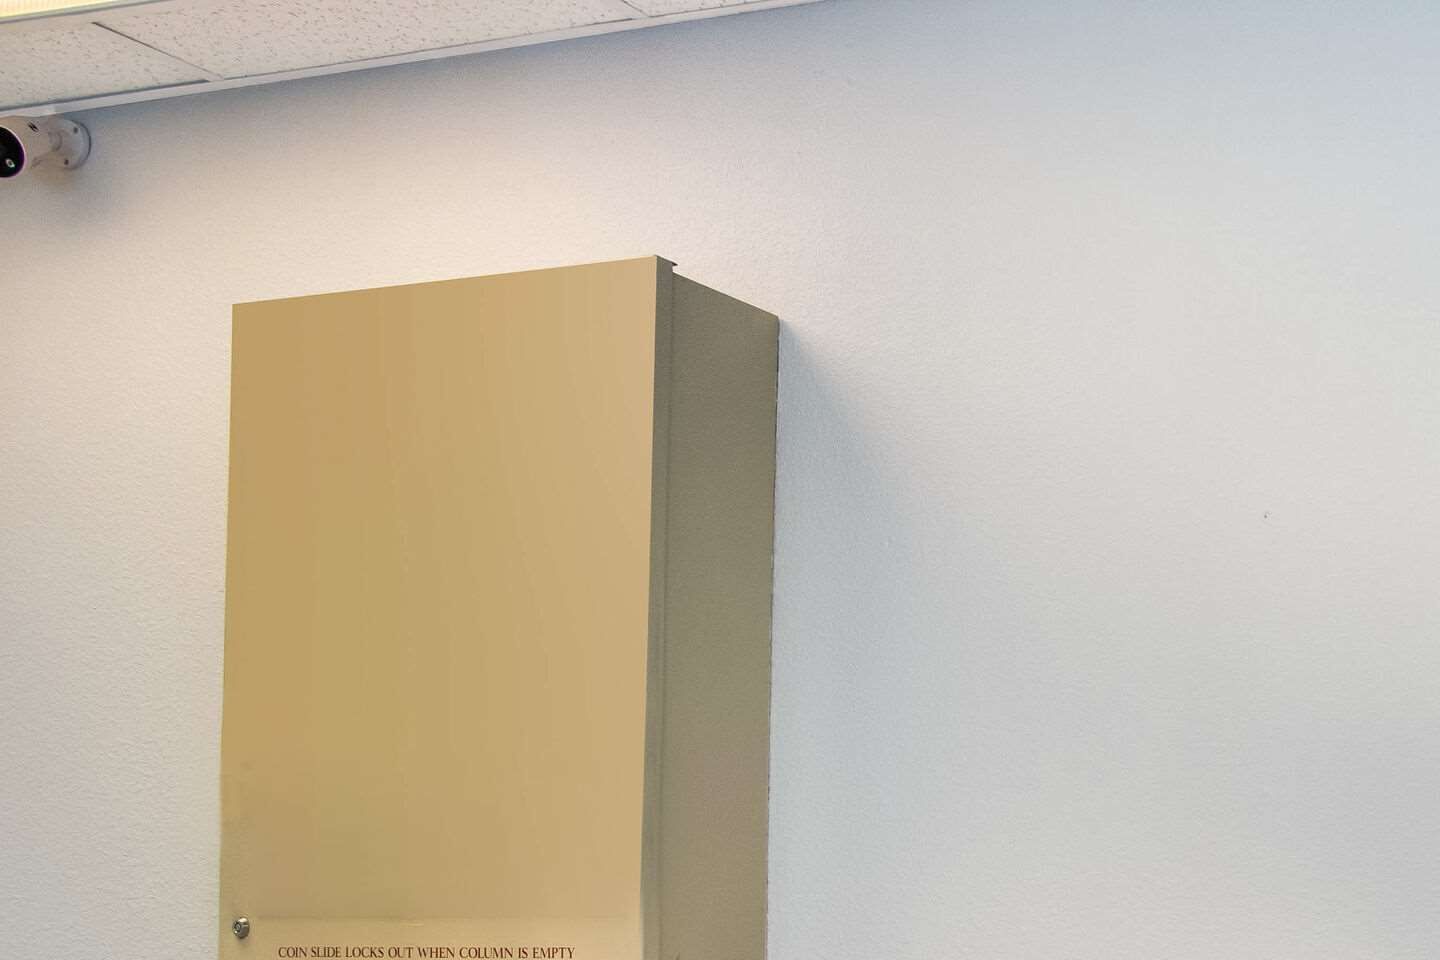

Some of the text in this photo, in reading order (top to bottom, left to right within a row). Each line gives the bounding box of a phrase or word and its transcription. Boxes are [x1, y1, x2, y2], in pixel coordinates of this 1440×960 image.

[278, 946, 575, 959] COIN SLIDE LOCKS OUT WHEN COLUMN IS EMPTY
